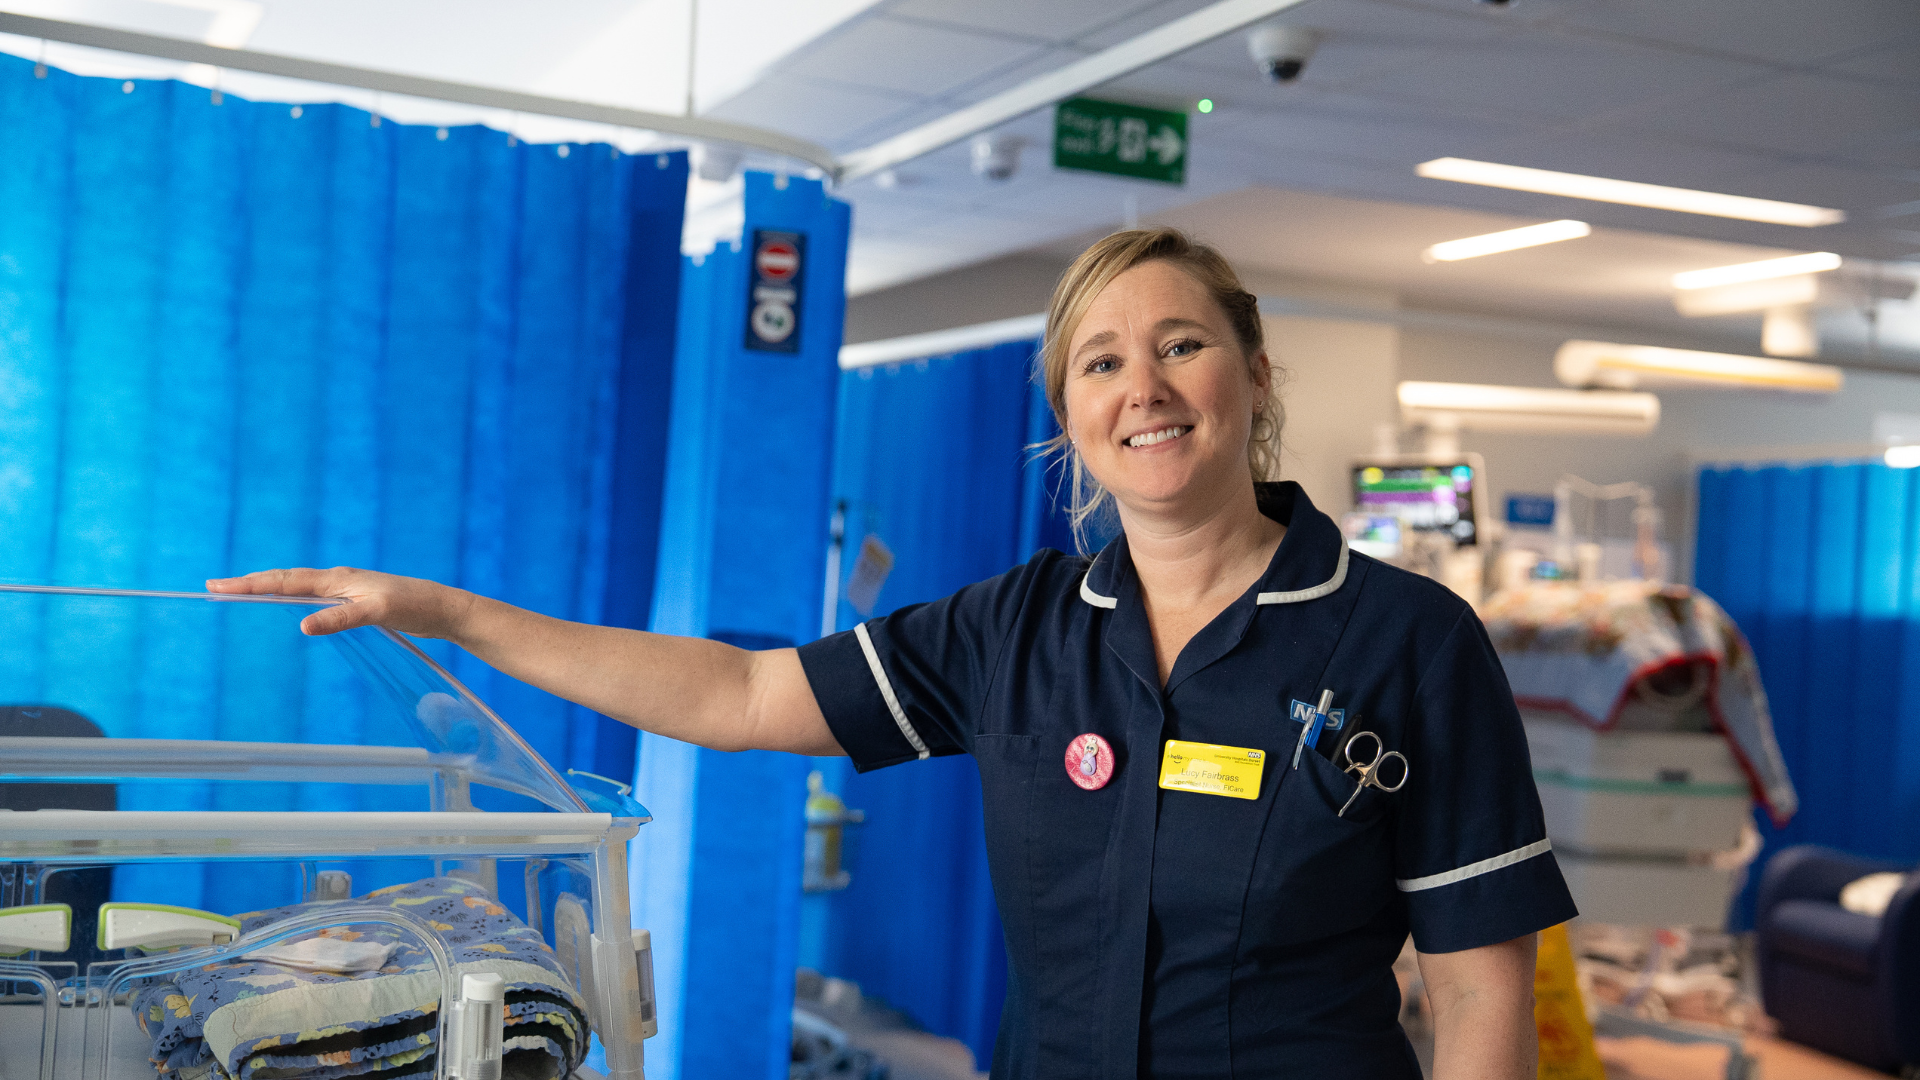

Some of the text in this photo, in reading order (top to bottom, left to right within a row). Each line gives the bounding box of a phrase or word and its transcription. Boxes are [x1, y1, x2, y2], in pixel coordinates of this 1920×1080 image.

[1293, 703, 1341, 727] NS
[1181, 768, 1239, 782] Lucy Fairbrass
